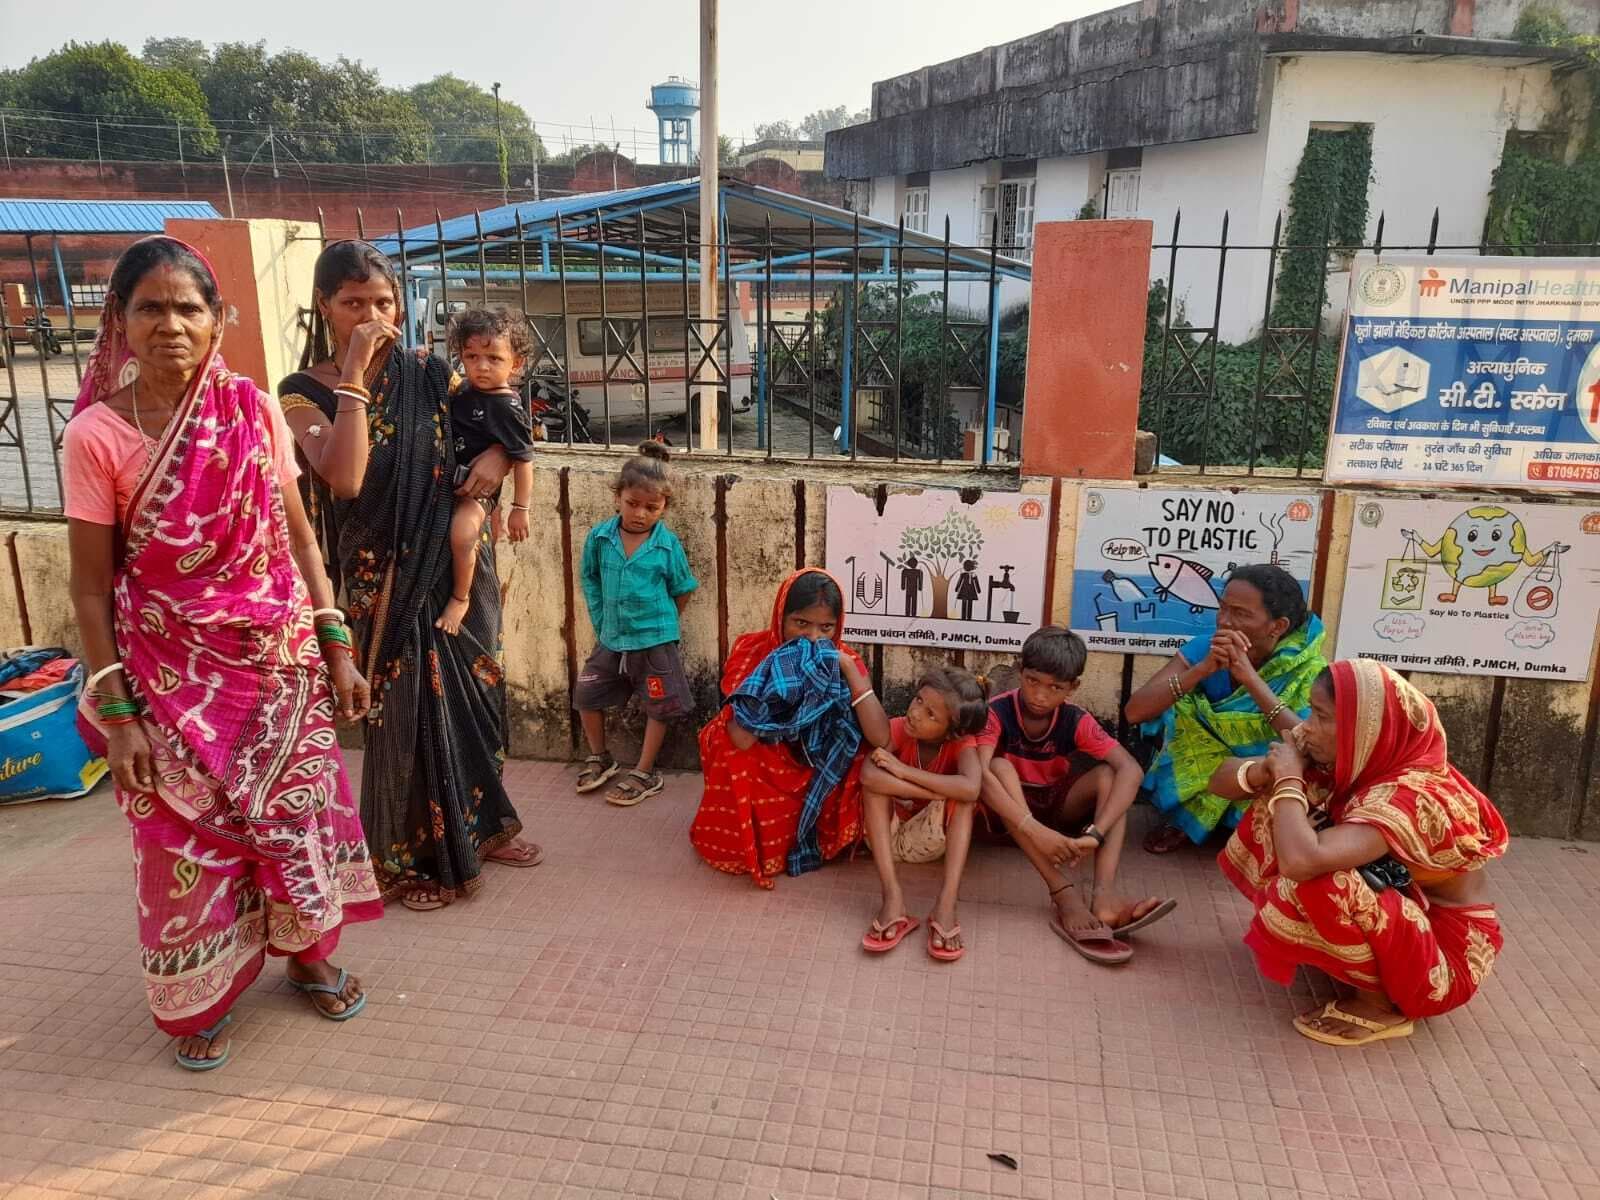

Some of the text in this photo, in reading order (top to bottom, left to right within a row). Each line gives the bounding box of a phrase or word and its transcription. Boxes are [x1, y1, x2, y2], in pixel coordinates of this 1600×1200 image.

[1395, 320, 1427, 339] मेडिकल
[1457, 326, 1495, 340] अस्पताल
[1566, 329, 1594, 349] दुमका
[1467, 357, 1548, 381] अत्याधुनिक
[1439, 381, 1568, 410] सी.टी. स्कैन
[1376, 440, 1408, 452] परिणाम
[1468, 443, 1481, 455] की
[1483, 443, 1512, 459] सुविधा
[1533, 448, 1562, 459] अधिक
[1422, 462, 1432, 471] 24
[1466, 461, 1483, 473] दिन
[1162, 498, 1235, 524] SAY NO
[1142, 527, 1258, 551] TO PLASTIC
[1106, 542, 1142, 558] help me
[1429, 609, 1445, 617] Say
[1447, 609, 1459, 617] No
[1474, 611, 1510, 620] Plastics
[879, 627, 906, 638] प्रबंधन
[941, 635, 982, 645] PJMCH,
[985, 636, 1022, 646] Dumka
[1088, 636, 1125, 646] अस्पताल
[1127, 637, 1156, 648] प्रबंधन
[1401, 653, 1431, 665] प्रबंधन
[1473, 658, 1520, 672] PJMCH,
[1524, 662, 1567, 673] Dumka
